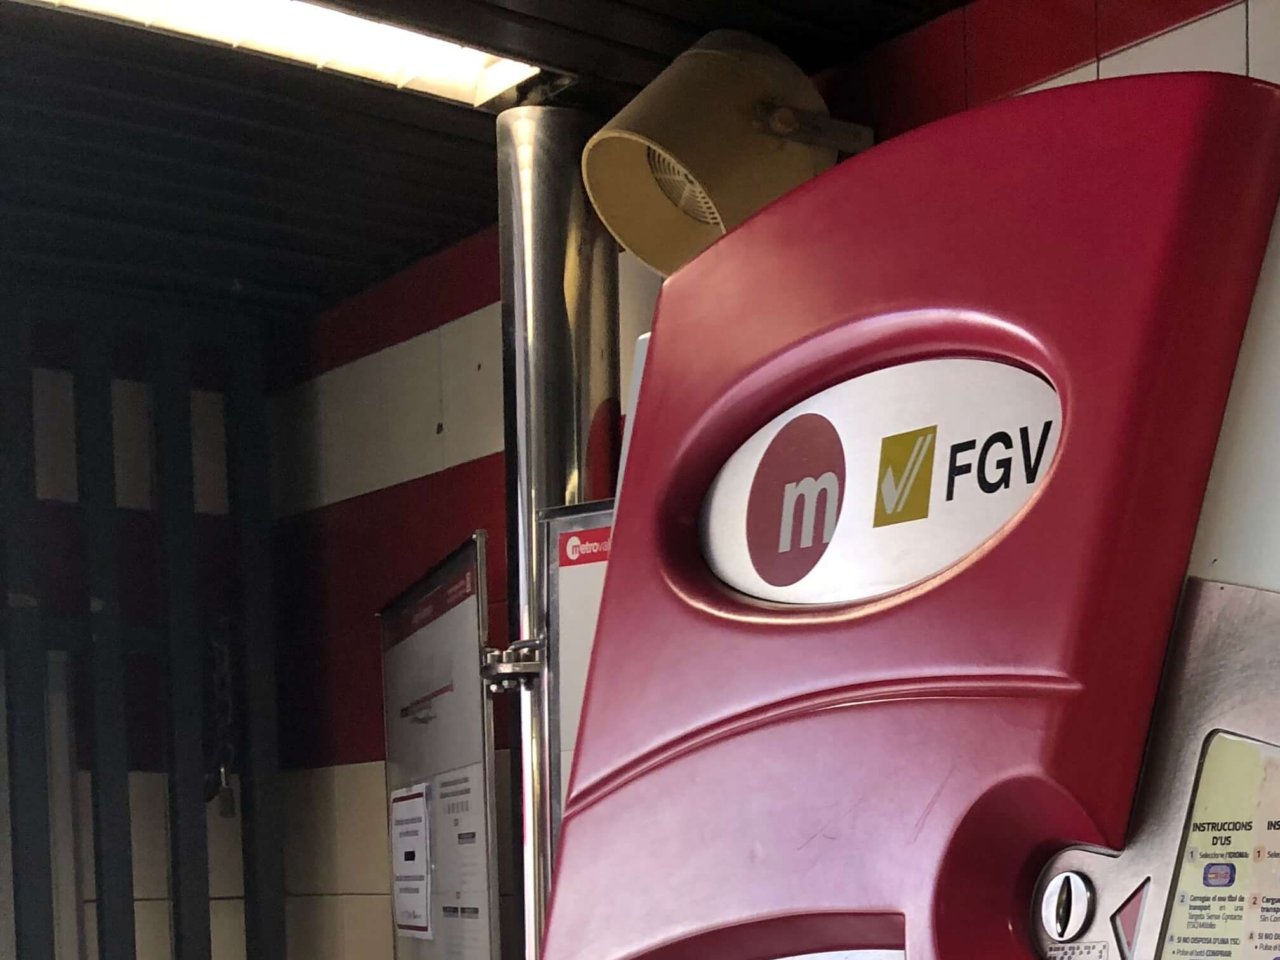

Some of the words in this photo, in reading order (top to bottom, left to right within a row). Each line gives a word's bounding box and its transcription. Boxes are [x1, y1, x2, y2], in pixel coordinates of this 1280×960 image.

[945, 419, 1053, 503] FGV
[1192, 820, 1253, 833] INSTRUCCIONS
[1211, 835, 1232, 846] D'US
